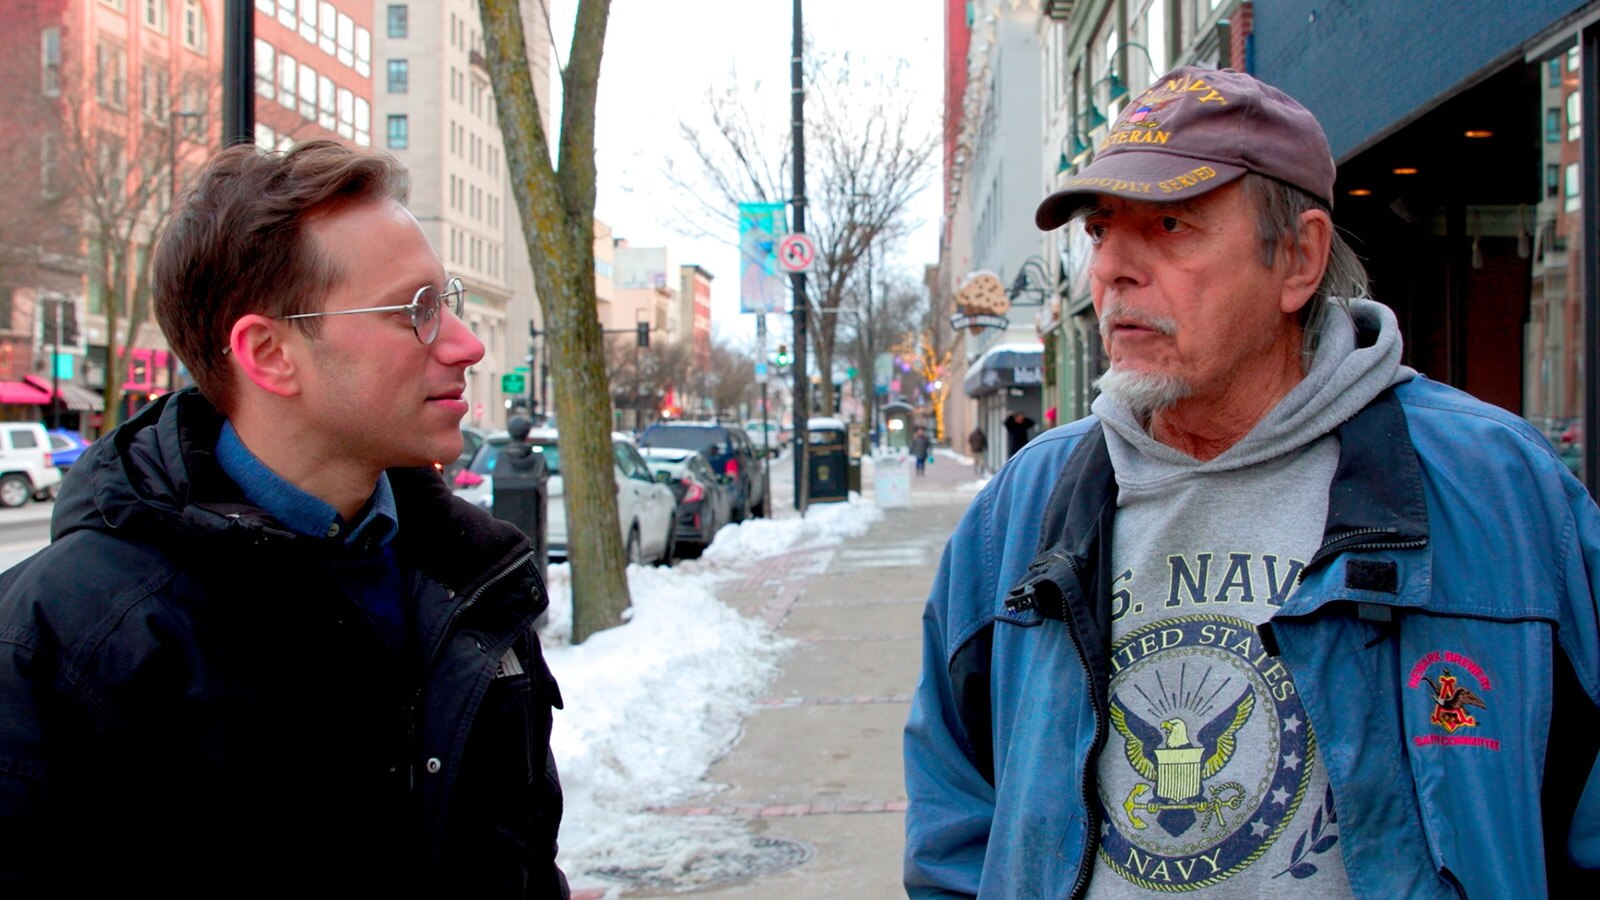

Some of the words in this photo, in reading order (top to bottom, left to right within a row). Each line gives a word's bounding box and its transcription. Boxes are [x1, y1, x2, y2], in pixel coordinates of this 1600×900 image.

[1166, 74, 1228, 105] NAVY
[1102, 129, 1171, 145] ETERAN
[1067, 177, 1151, 194] ROUDLY
[1158, 166, 1217, 193] SERVED
[1164, 552, 1305, 609] NAV
[1109, 628, 1184, 678] ITED
[1199, 625, 1295, 701] STATES
[1124, 847, 1221, 882] NAVY
